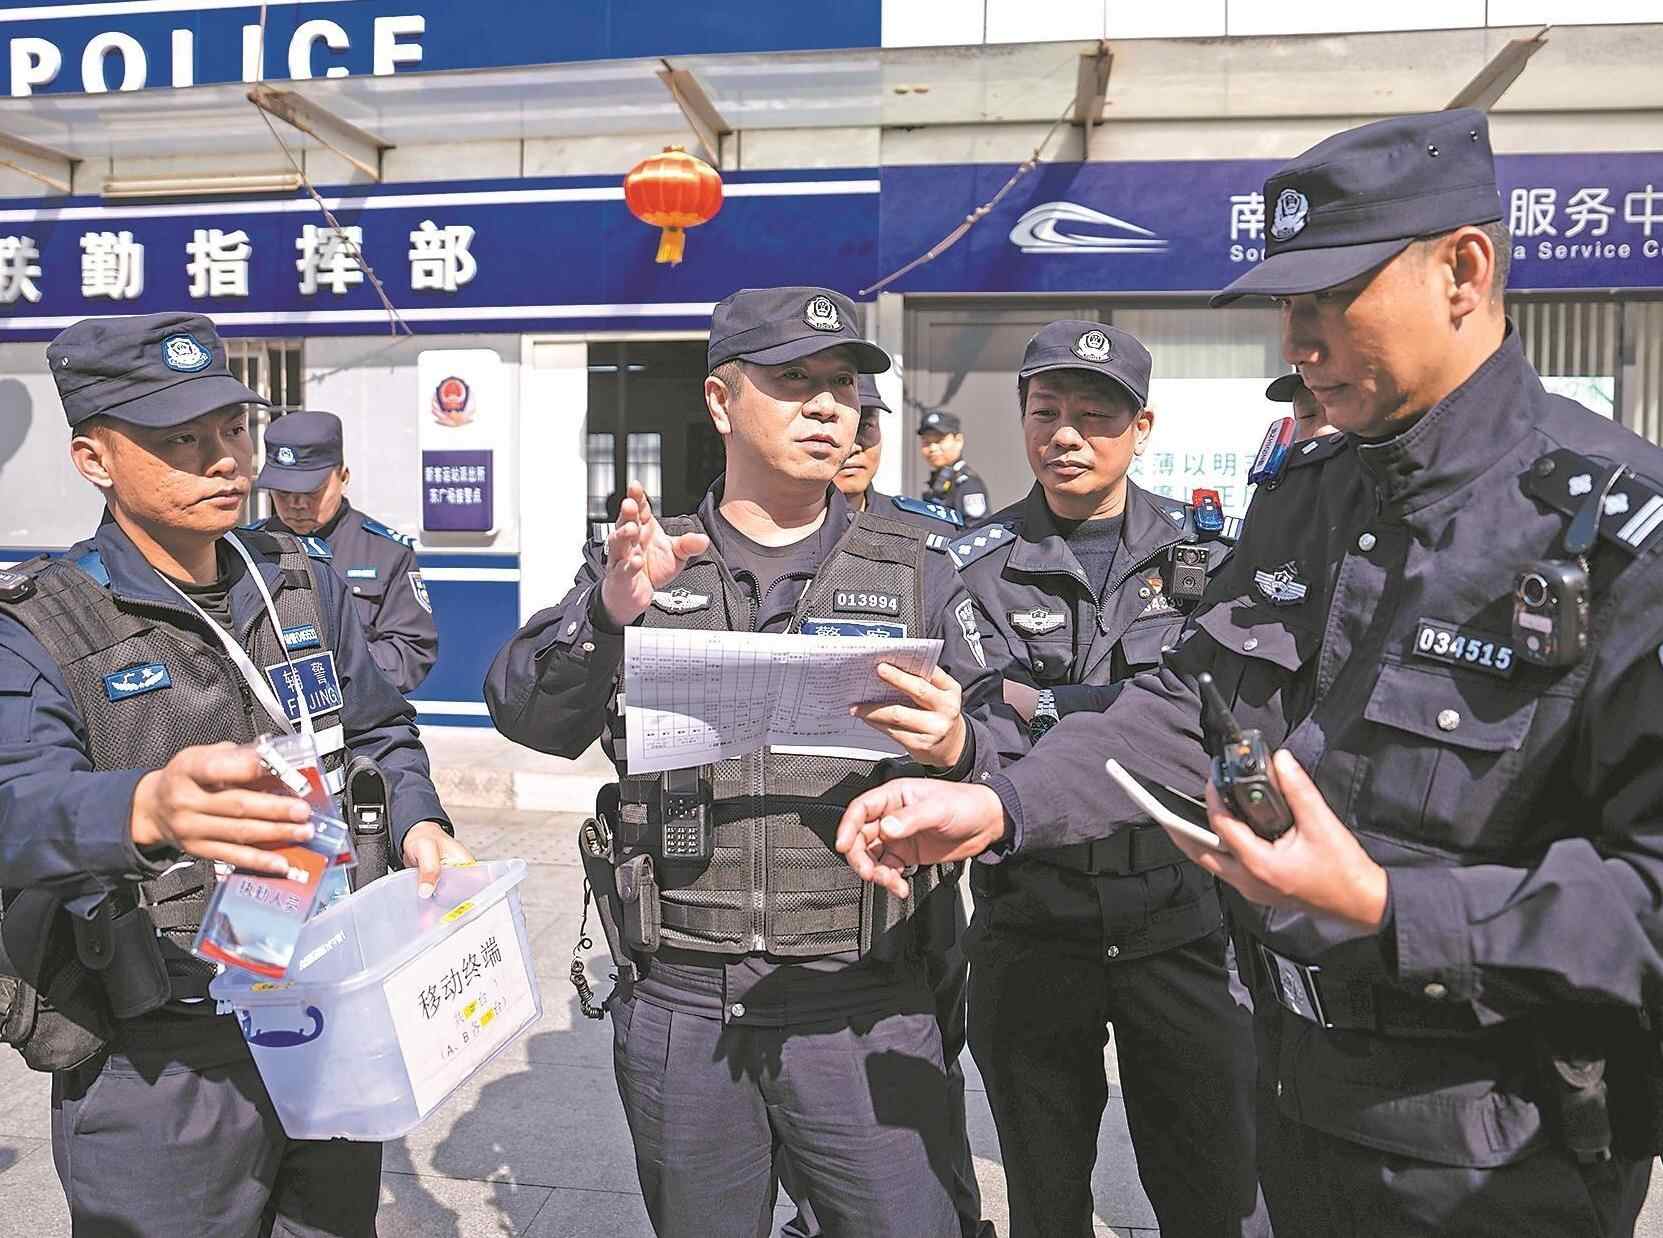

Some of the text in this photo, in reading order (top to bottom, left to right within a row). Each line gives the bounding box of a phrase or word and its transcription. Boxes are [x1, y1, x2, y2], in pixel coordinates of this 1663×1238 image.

[1538, 240, 1631, 260] Service
[837, 593, 898, 611] 013994
[1418, 628, 1513, 670] 034515
[287, 686, 339, 716] FJING
[418, 936, 502, 1020] 移动终端
